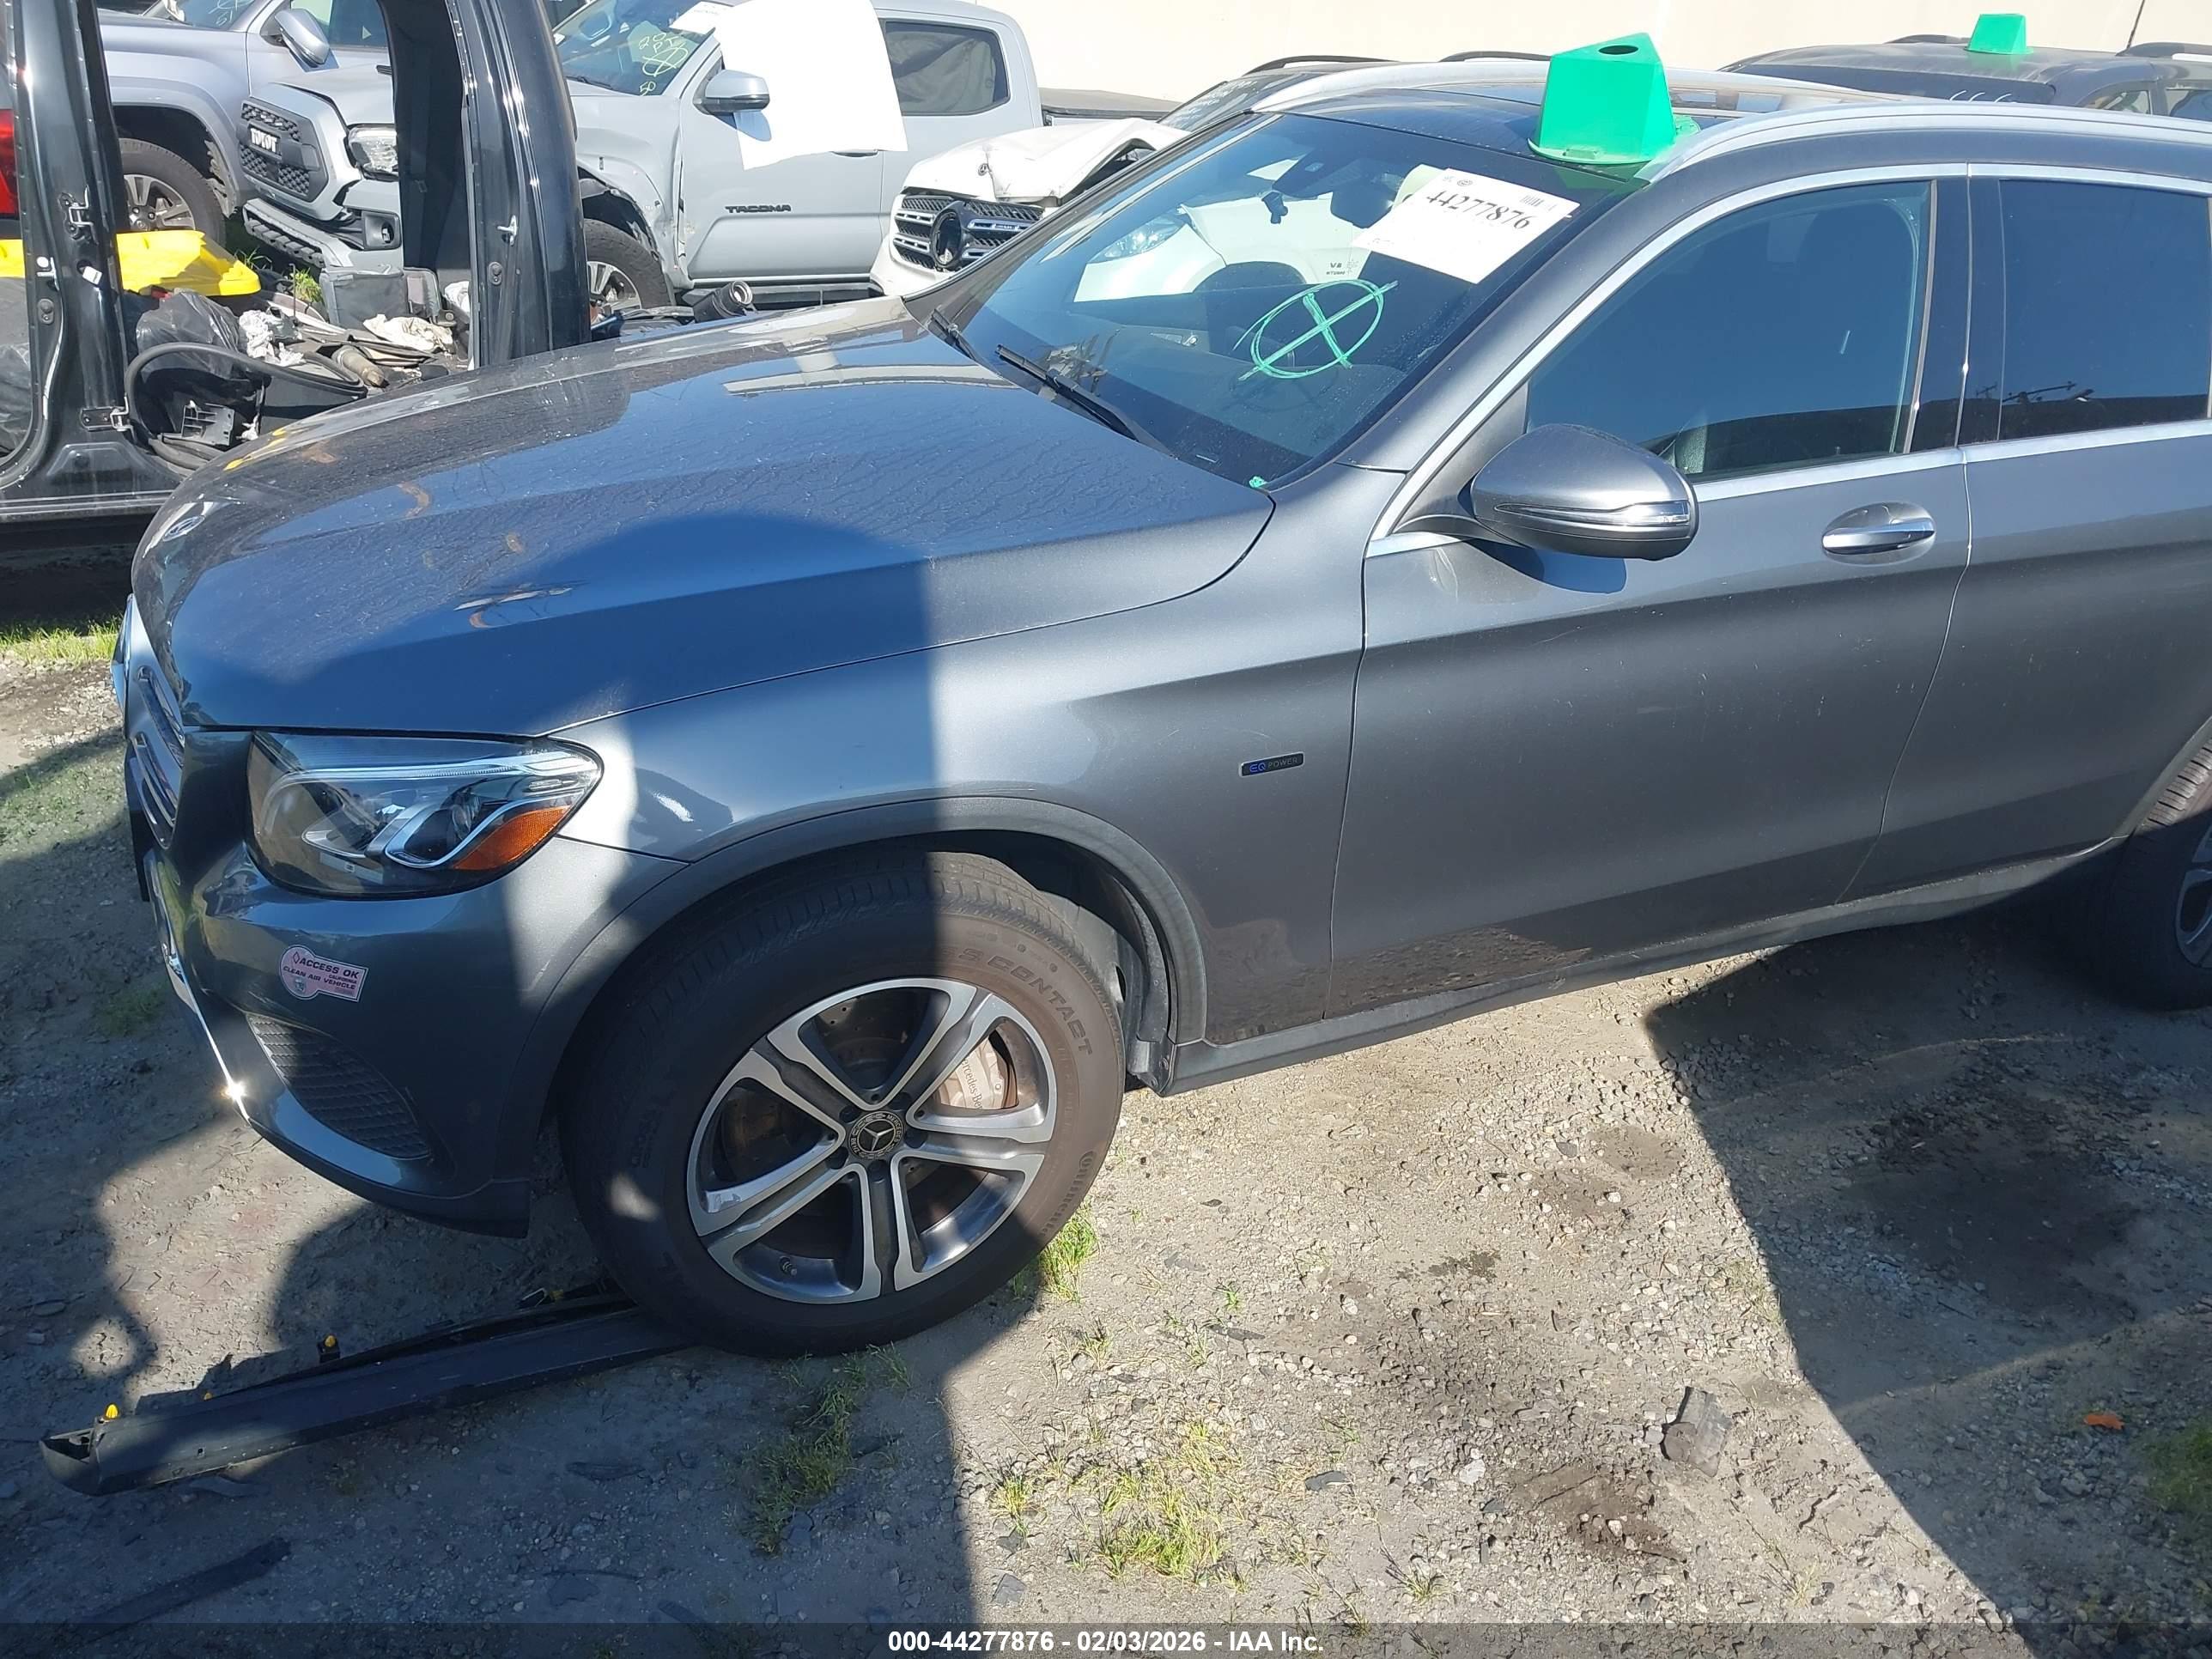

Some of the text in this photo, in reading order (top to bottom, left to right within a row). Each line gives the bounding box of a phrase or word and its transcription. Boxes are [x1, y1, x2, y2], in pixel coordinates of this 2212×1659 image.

[725, 204, 791, 214] TACOMA
[1425, 190, 1535, 229] 44277876
[1249, 757, 1297, 773] EQ POWER
[283, 965, 307, 977] CLEAN
[324, 977, 356, 990] VEHICLE
[300, 957, 359, 979] ACCESS OK
[328, 974, 357, 985] CALIFORNIA
[988, 955, 1093, 1055] CONTACT
[962, 1059, 983, 1109] ercedes-Be
[886, 1114, 902, 1143] MERCEDES
